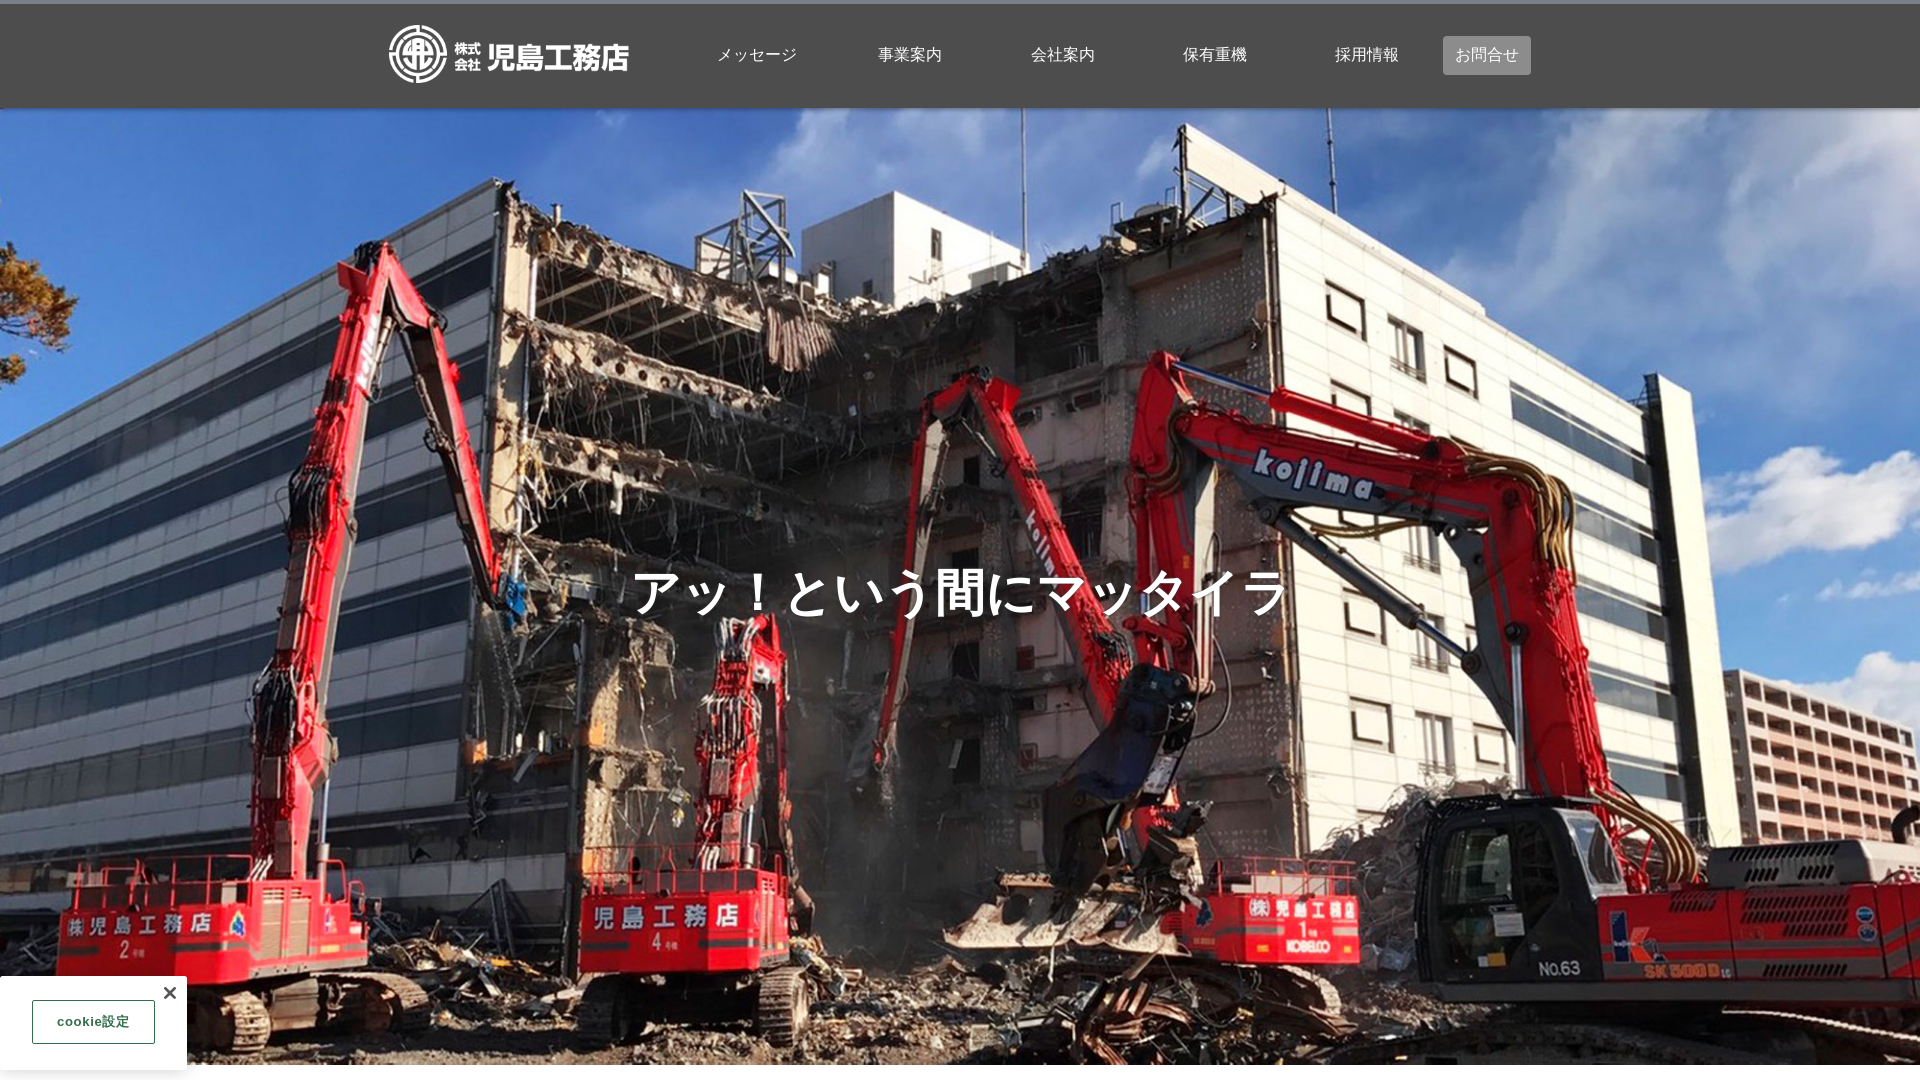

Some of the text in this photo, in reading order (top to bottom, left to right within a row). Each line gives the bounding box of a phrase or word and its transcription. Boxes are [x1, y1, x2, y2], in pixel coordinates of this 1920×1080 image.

[1253, 448, 1374, 501] kojima
[594, 903, 738, 930] 児島工務店
